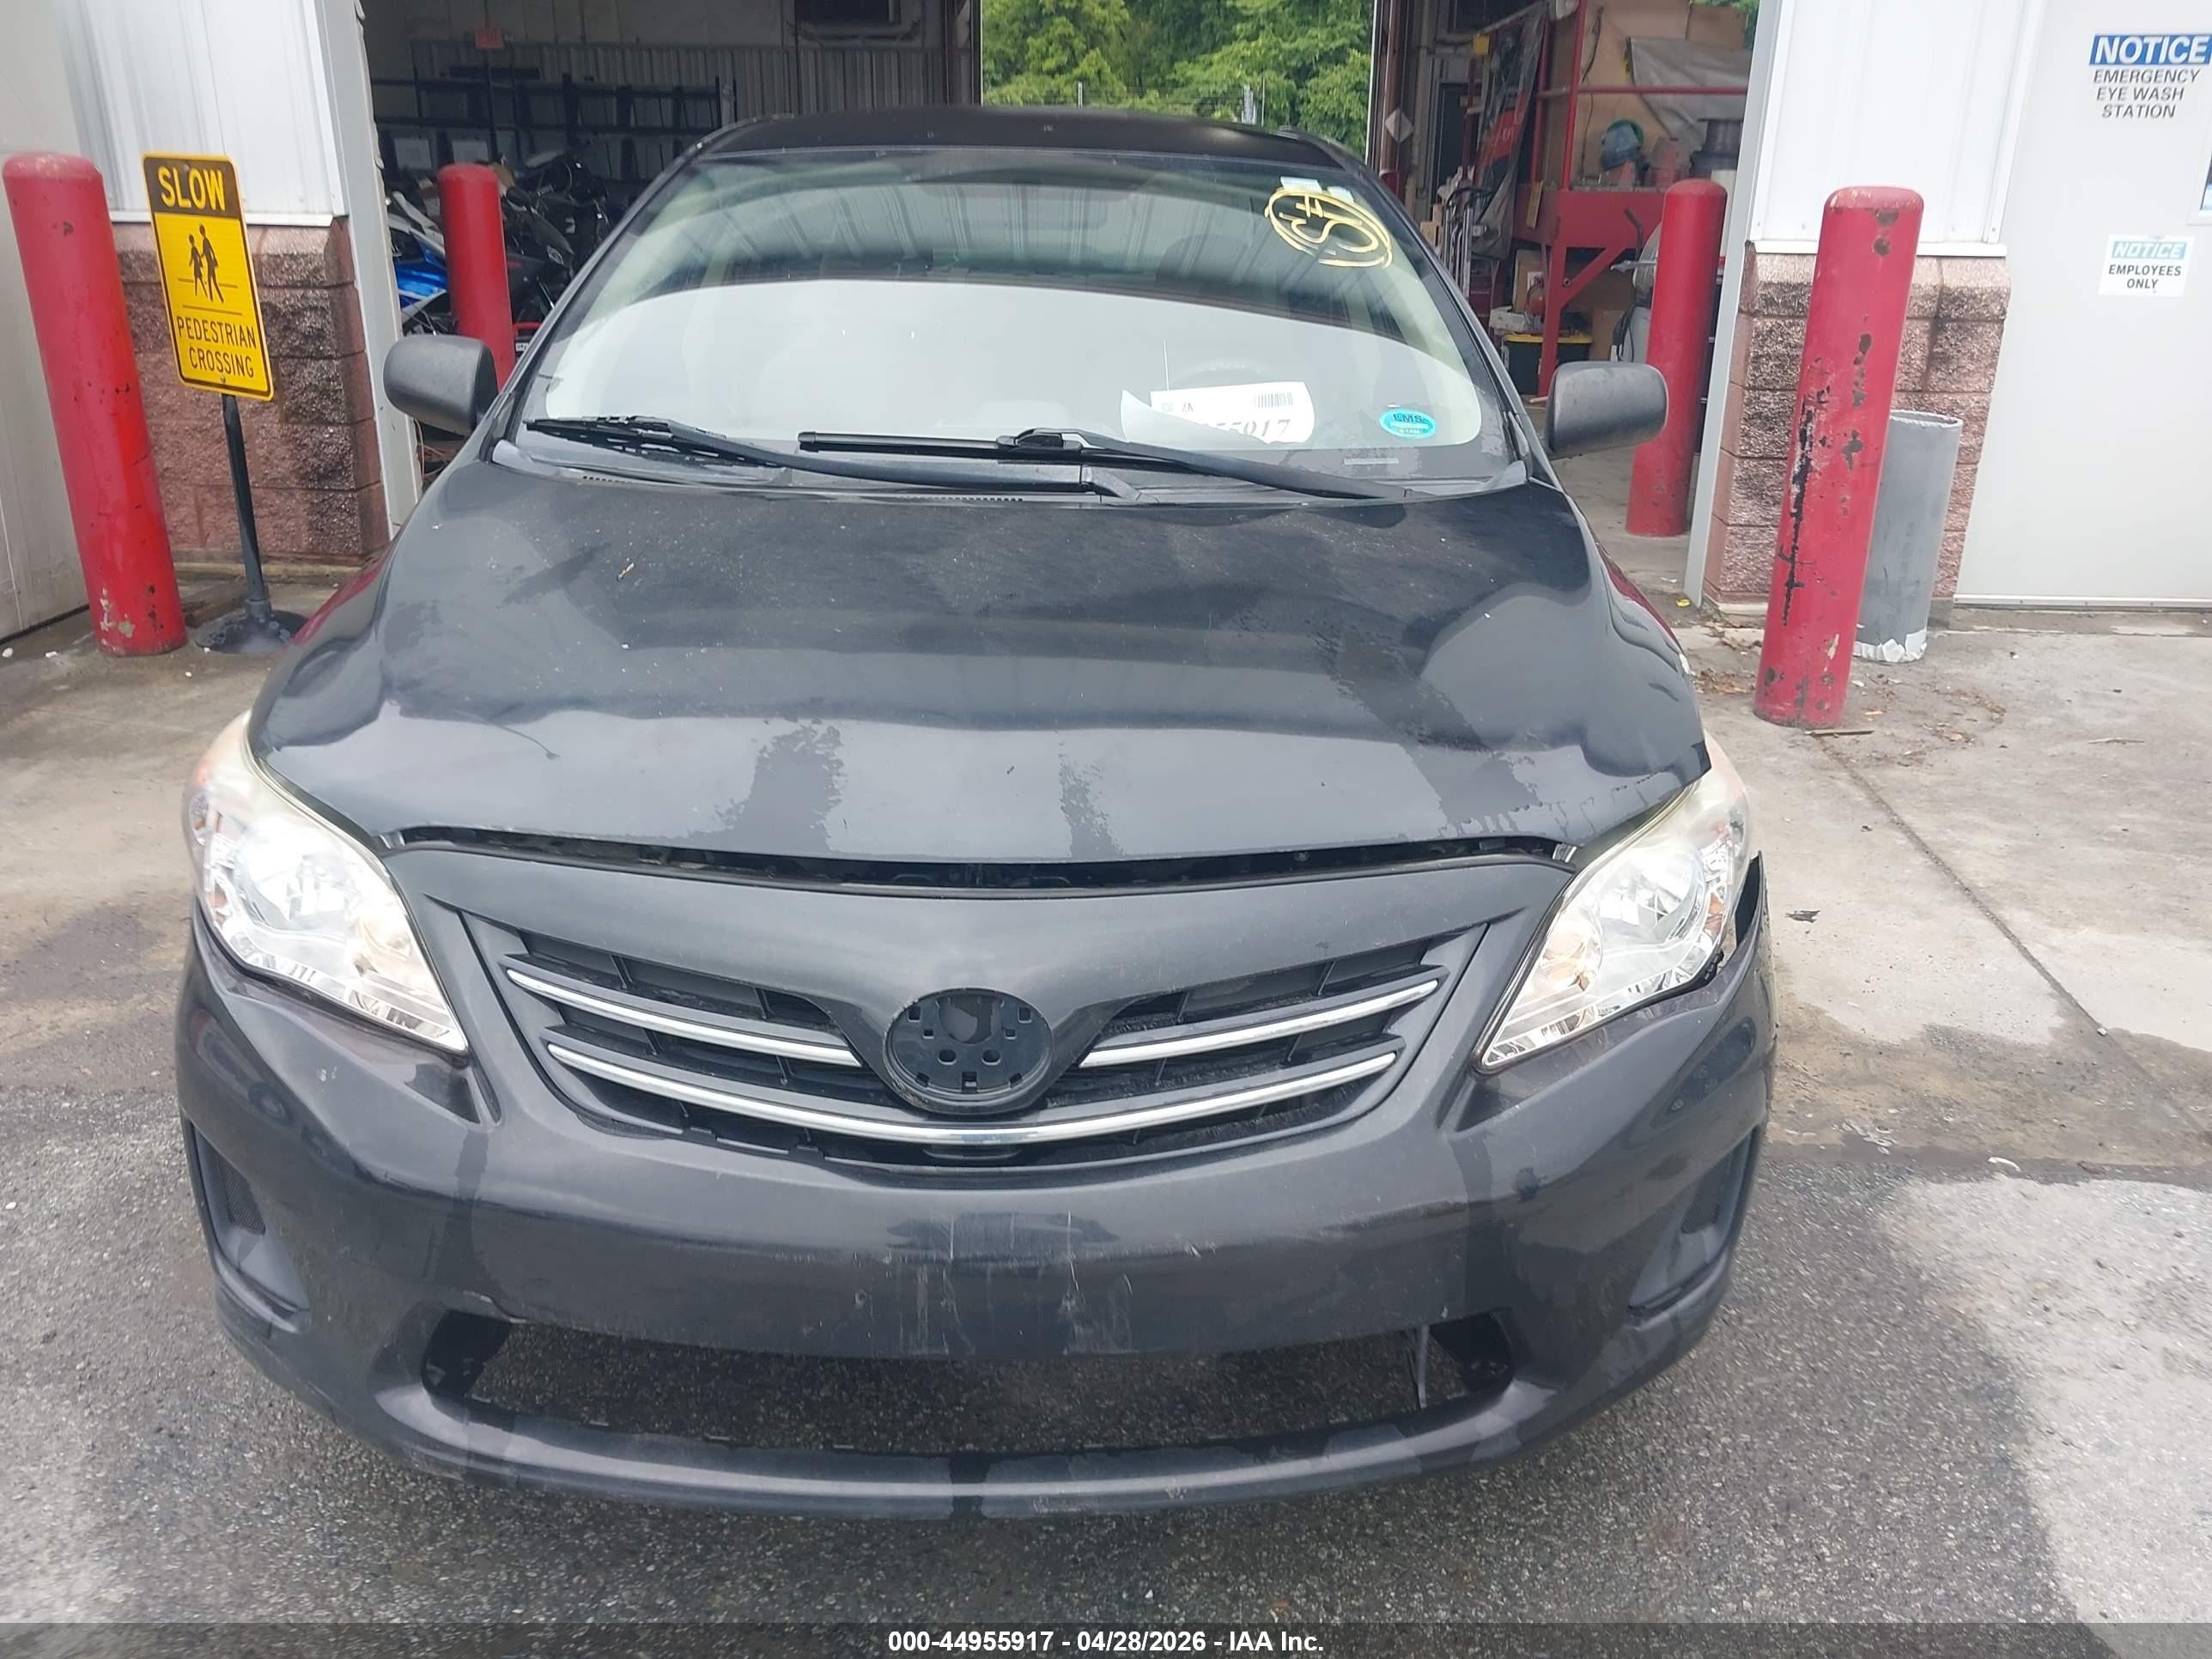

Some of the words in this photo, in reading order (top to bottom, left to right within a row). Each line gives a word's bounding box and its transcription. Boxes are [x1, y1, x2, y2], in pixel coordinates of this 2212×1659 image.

[2094, 35, 2210, 64] NOTICE
[2093, 69, 2200, 84] EMERGENCY
[2096, 87, 2128, 101] EYE
[2133, 87, 2185, 101] WASH
[2101, 104, 2177, 119] STATION
[158, 166, 226, 211] SLOW
[2112, 241, 2185, 258] NOTICE
[2108, 264, 2183, 276] EMPLOYEES
[2126, 278, 2160, 289] ONLY
[176, 316, 257, 349] PEDESTRIAN
[189, 347, 254, 378] CROSSING
